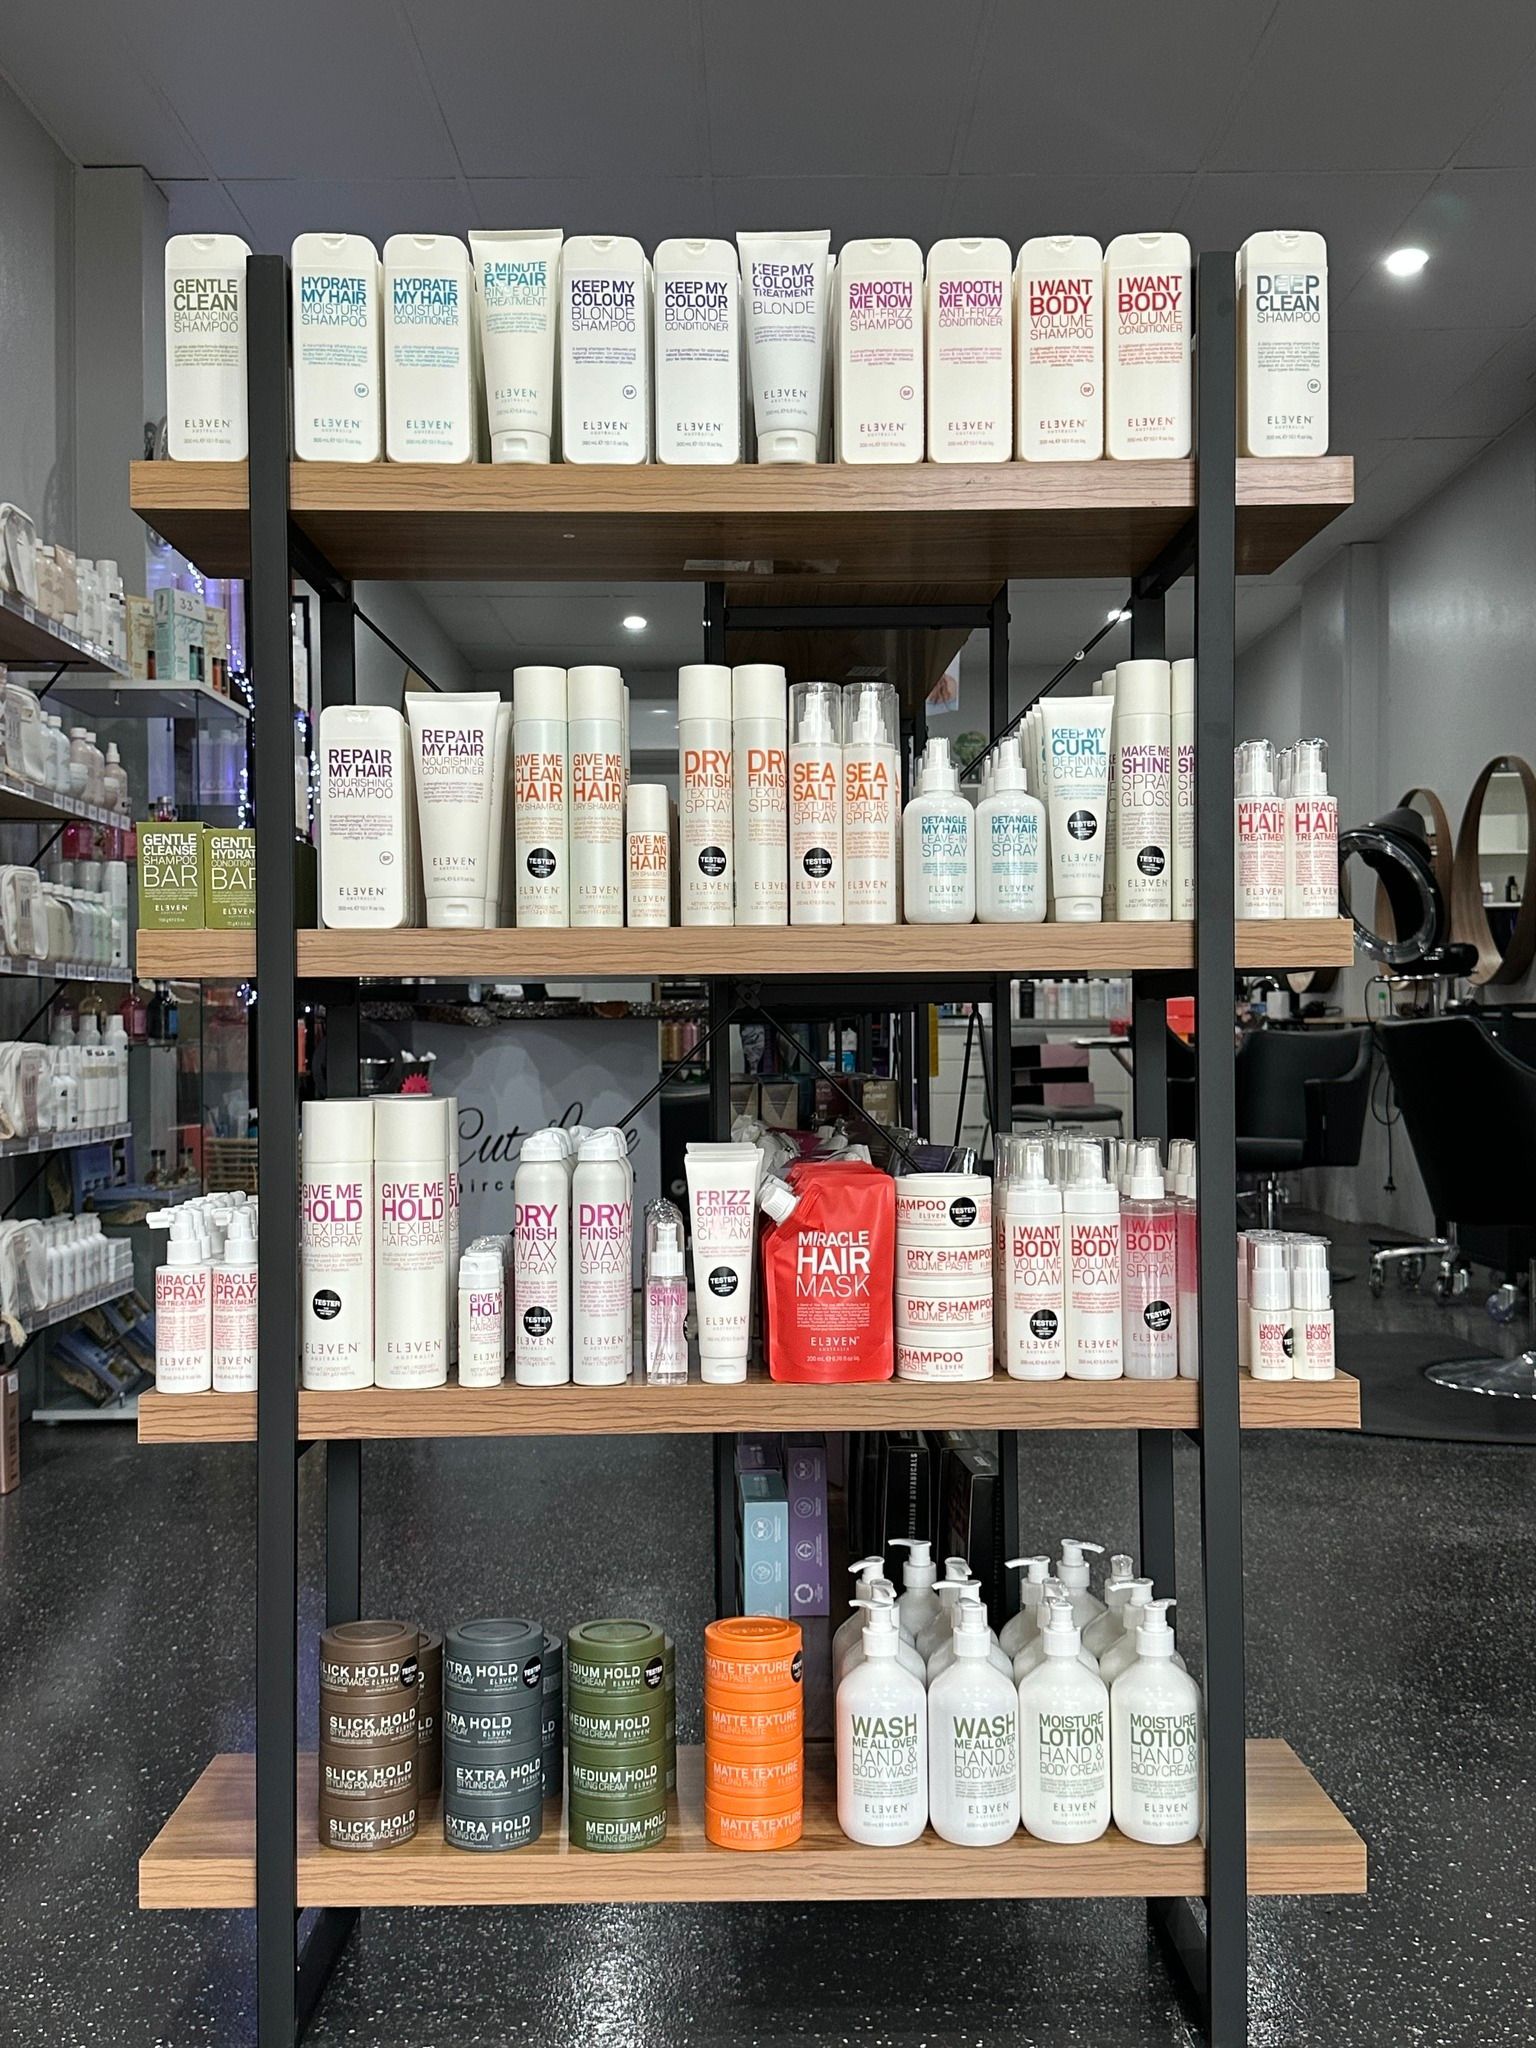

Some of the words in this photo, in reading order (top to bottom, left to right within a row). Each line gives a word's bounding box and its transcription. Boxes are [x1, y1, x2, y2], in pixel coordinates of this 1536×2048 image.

[484, 263, 491, 272] 3
[495, 262, 546, 272] MINUTE
[174, 279, 237, 293] GENTLE
[301, 277, 366, 291] HYDRATE
[394, 279, 457, 292] HYDRATE
[572, 280, 607, 292] KEEP
[612, 281, 634, 293] MY
[665, 282, 702, 293] KEEP
[706, 282, 727, 294] MY
[850, 282, 912, 296] SMOOTH
[1030, 281, 1033, 296] I
[1036, 280, 1092, 296] WANT
[1119, 279, 1122, 293] I
[1124, 276, 1182, 292] WANT
[1257, 275, 1320, 294] DEEP
[174, 294, 237, 311] CLEAN
[302, 290, 326, 302] MY
[329, 291, 366, 304] HAIR
[394, 292, 417, 303] MY
[421, 293, 457, 305] HAIR
[486, 296, 546, 307] TREATMENT
[572, 294, 634, 306] COLOUR
[665, 295, 728, 308] COLOUR
[850, 296, 872, 309] ME
[876, 296, 912, 308] NOW
[1118, 292, 1182, 313] BODY
[302, 303, 366, 316] MOISTURE
[394, 304, 457, 316] MOISTURE
[753, 302, 815, 314] BLONDE
[1030, 296, 1092, 316] BODY
[1256, 296, 1320, 312] CLEAN
[174, 312, 238, 321] BALANCING
[572, 307, 634, 320] BLONDE
[665, 309, 728, 321] BLONDE
[850, 309, 912, 319] ANTI-FRIZZ
[1119, 311, 1182, 325] VOLUME
[1257, 312, 1320, 323] SHAMPOO
[174, 322, 238, 332] SHAMPOO
[302, 314, 367, 327] SHAMPOO
[394, 316, 458, 325] CONDITIONER
[572, 321, 635, 332] SHAMPOO
[665, 321, 728, 331] CONDITIONER
[850, 319, 912, 331] SHAMPOO
[1031, 315, 1093, 328] VOLUME
[1030, 329, 1093, 340] SHAMPOO
[1118, 324, 1182, 335] CONDITIONER
[422, 730, 484, 743] REPAIR
[422, 744, 445, 756] MY
[448, 744, 484, 756] HAIR
[1052, 740, 1106, 755] CURL
[1122, 746, 1155, 757] MAKE
[329, 750, 392, 764] REPAIR
[422, 757, 484, 766] NOURISHING
[573, 754, 602, 767] GIVE
[606, 754, 621, 766] ME
[1053, 756, 1106, 766] DEFINING
[329, 765, 352, 777] MY
[356, 765, 392, 777] HAIR
[422, 766, 484, 775] CONDITIONER
[794, 763, 835, 782] SEA
[1122, 758, 1169, 774] SHINE
[573, 767, 620, 781] CLEAN
[1053, 767, 1106, 779] CREAM
[328, 779, 392, 788] NOURISHING
[328, 788, 393, 799] SHAMPOO
[573, 783, 621, 801] HAIR
[794, 784, 836, 801] SALT
[794, 801, 837, 811] TEXTURE
[794, 812, 837, 824] SPRAY
[922, 816, 967, 824] DETANGLE
[1069, 820, 1096, 828] TESTER
[922, 824, 938, 834] MY
[943, 824, 967, 834] HAIR
[143, 834, 196, 846] GENTLE
[630, 836, 650, 845] GIVE
[654, 836, 666, 844] ME
[922, 834, 967, 844] LEAVE-IN
[143, 846, 196, 855] CLEANSE
[630, 845, 666, 856] CLEAN
[922, 844, 967, 857] SPRAY
[143, 856, 197, 865] SHAMPOO
[528, 858, 555, 866] TESTER
[630, 856, 666, 870] HAIR
[805, 858, 832, 866] TESTER
[143, 865, 198, 888] BAR
[382, 1184, 419, 1198] GIVE
[424, 1184, 444, 1197] ME
[697, 1190, 750, 1206] FRIZZ
[382, 1198, 444, 1221] HOLD
[580, 1205, 624, 1226] DRY
[697, 1207, 750, 1216] CONTROL
[382, 1221, 444, 1234] FLEXIBLE
[1014, 1227, 1016, 1239] I
[1019, 1225, 1060, 1239] WANT
[382, 1234, 444, 1246] HAIRSPRAY
[799, 1231, 869, 1247] MIRACLE
[1126, 1234, 1173, 1250] BODY
[908, 1250, 933, 1260] DRY
[1014, 1240, 1060, 1257] BODY
[797, 1249, 870, 1275] HAIR
[908, 1261, 943, 1270] VOLUME
[946, 1261, 972, 1270] PASTE
[1014, 1257, 1061, 1270] VOLUME
[1127, 1264, 1174, 1278] SPRAY
[157, 1274, 205, 1285] MIRACLE
[710, 1275, 736, 1284] TESTER
[1014, 1271, 1062, 1286] FOAM
[157, 1285, 205, 1299] SPRAY
[796, 1276, 870, 1297] MASK
[314, 1299, 341, 1307] TESTER
[650, 1295, 685, 1305] SHINE
[525, 1315, 551, 1323] TESTER
[1306, 1331, 1331, 1340] BODY
[1040, 1711, 1103, 1727] MOISTURE
[851, 1714, 917, 1738] WASH
[853, 1738, 867, 1748] ME
[870, 1738, 890, 1749] ALL
[892, 1736, 917, 1748] OVER
[1040, 1725, 1104, 1747] LOTION
[853, 1750, 903, 1766] HAND
[908, 1747, 917, 1763] &
[1040, 1746, 1091, 1764] HAND
[1096, 1744, 1103, 1760] &
[326, 1766, 367, 1780] SLICK
[374, 1761, 412, 1780] HOLD
[457, 1768, 504, 1781] EXTRA
[511, 1759, 540, 1779] HOLD
[574, 1765, 621, 1781] MEDIUM
[626, 1765, 657, 1781] HOLD
[714, 1763, 748, 1776] MATTE
[752, 1762, 798, 1778] TEXTURE
[853, 1764, 882, 1778] BODY
[886, 1764, 917, 1778] WASH
[1040, 1762, 1068, 1776] BODY
[1070, 1762, 1104, 1775] CREAM
[326, 1779, 353, 1789] STYLING
[354, 1779, 388, 1789] POMADE
[457, 1780, 487, 1789] STYLING
[488, 1780, 508, 1788] CLAY
